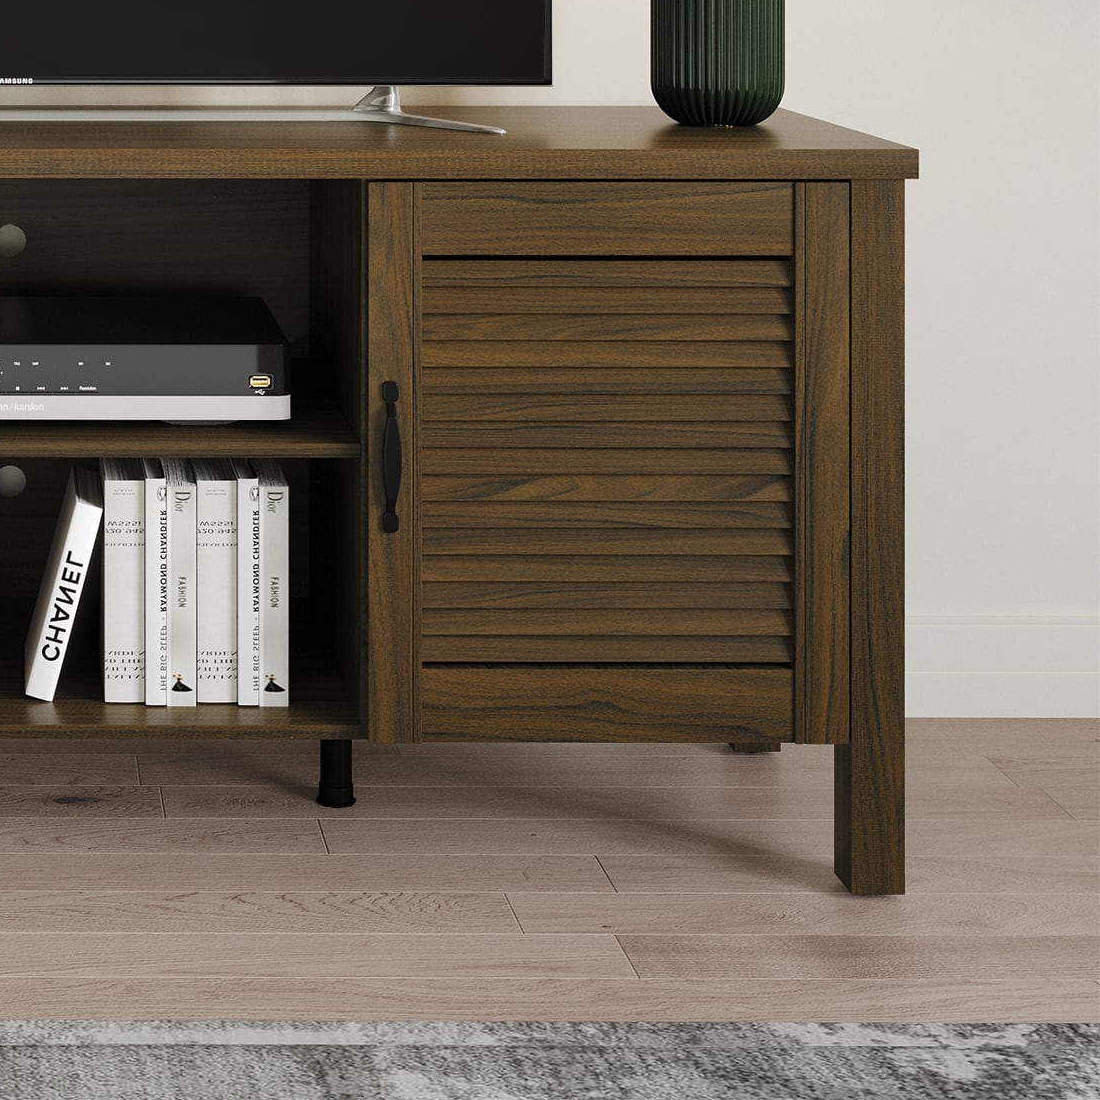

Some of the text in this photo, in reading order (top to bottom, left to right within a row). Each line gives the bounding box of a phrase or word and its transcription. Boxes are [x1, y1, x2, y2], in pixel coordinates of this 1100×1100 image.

[175, 491, 191, 513] Dior
[267, 491, 284, 513] Dior
[177, 576, 187, 608] FASHION
[270, 576, 280, 608] FASHION
